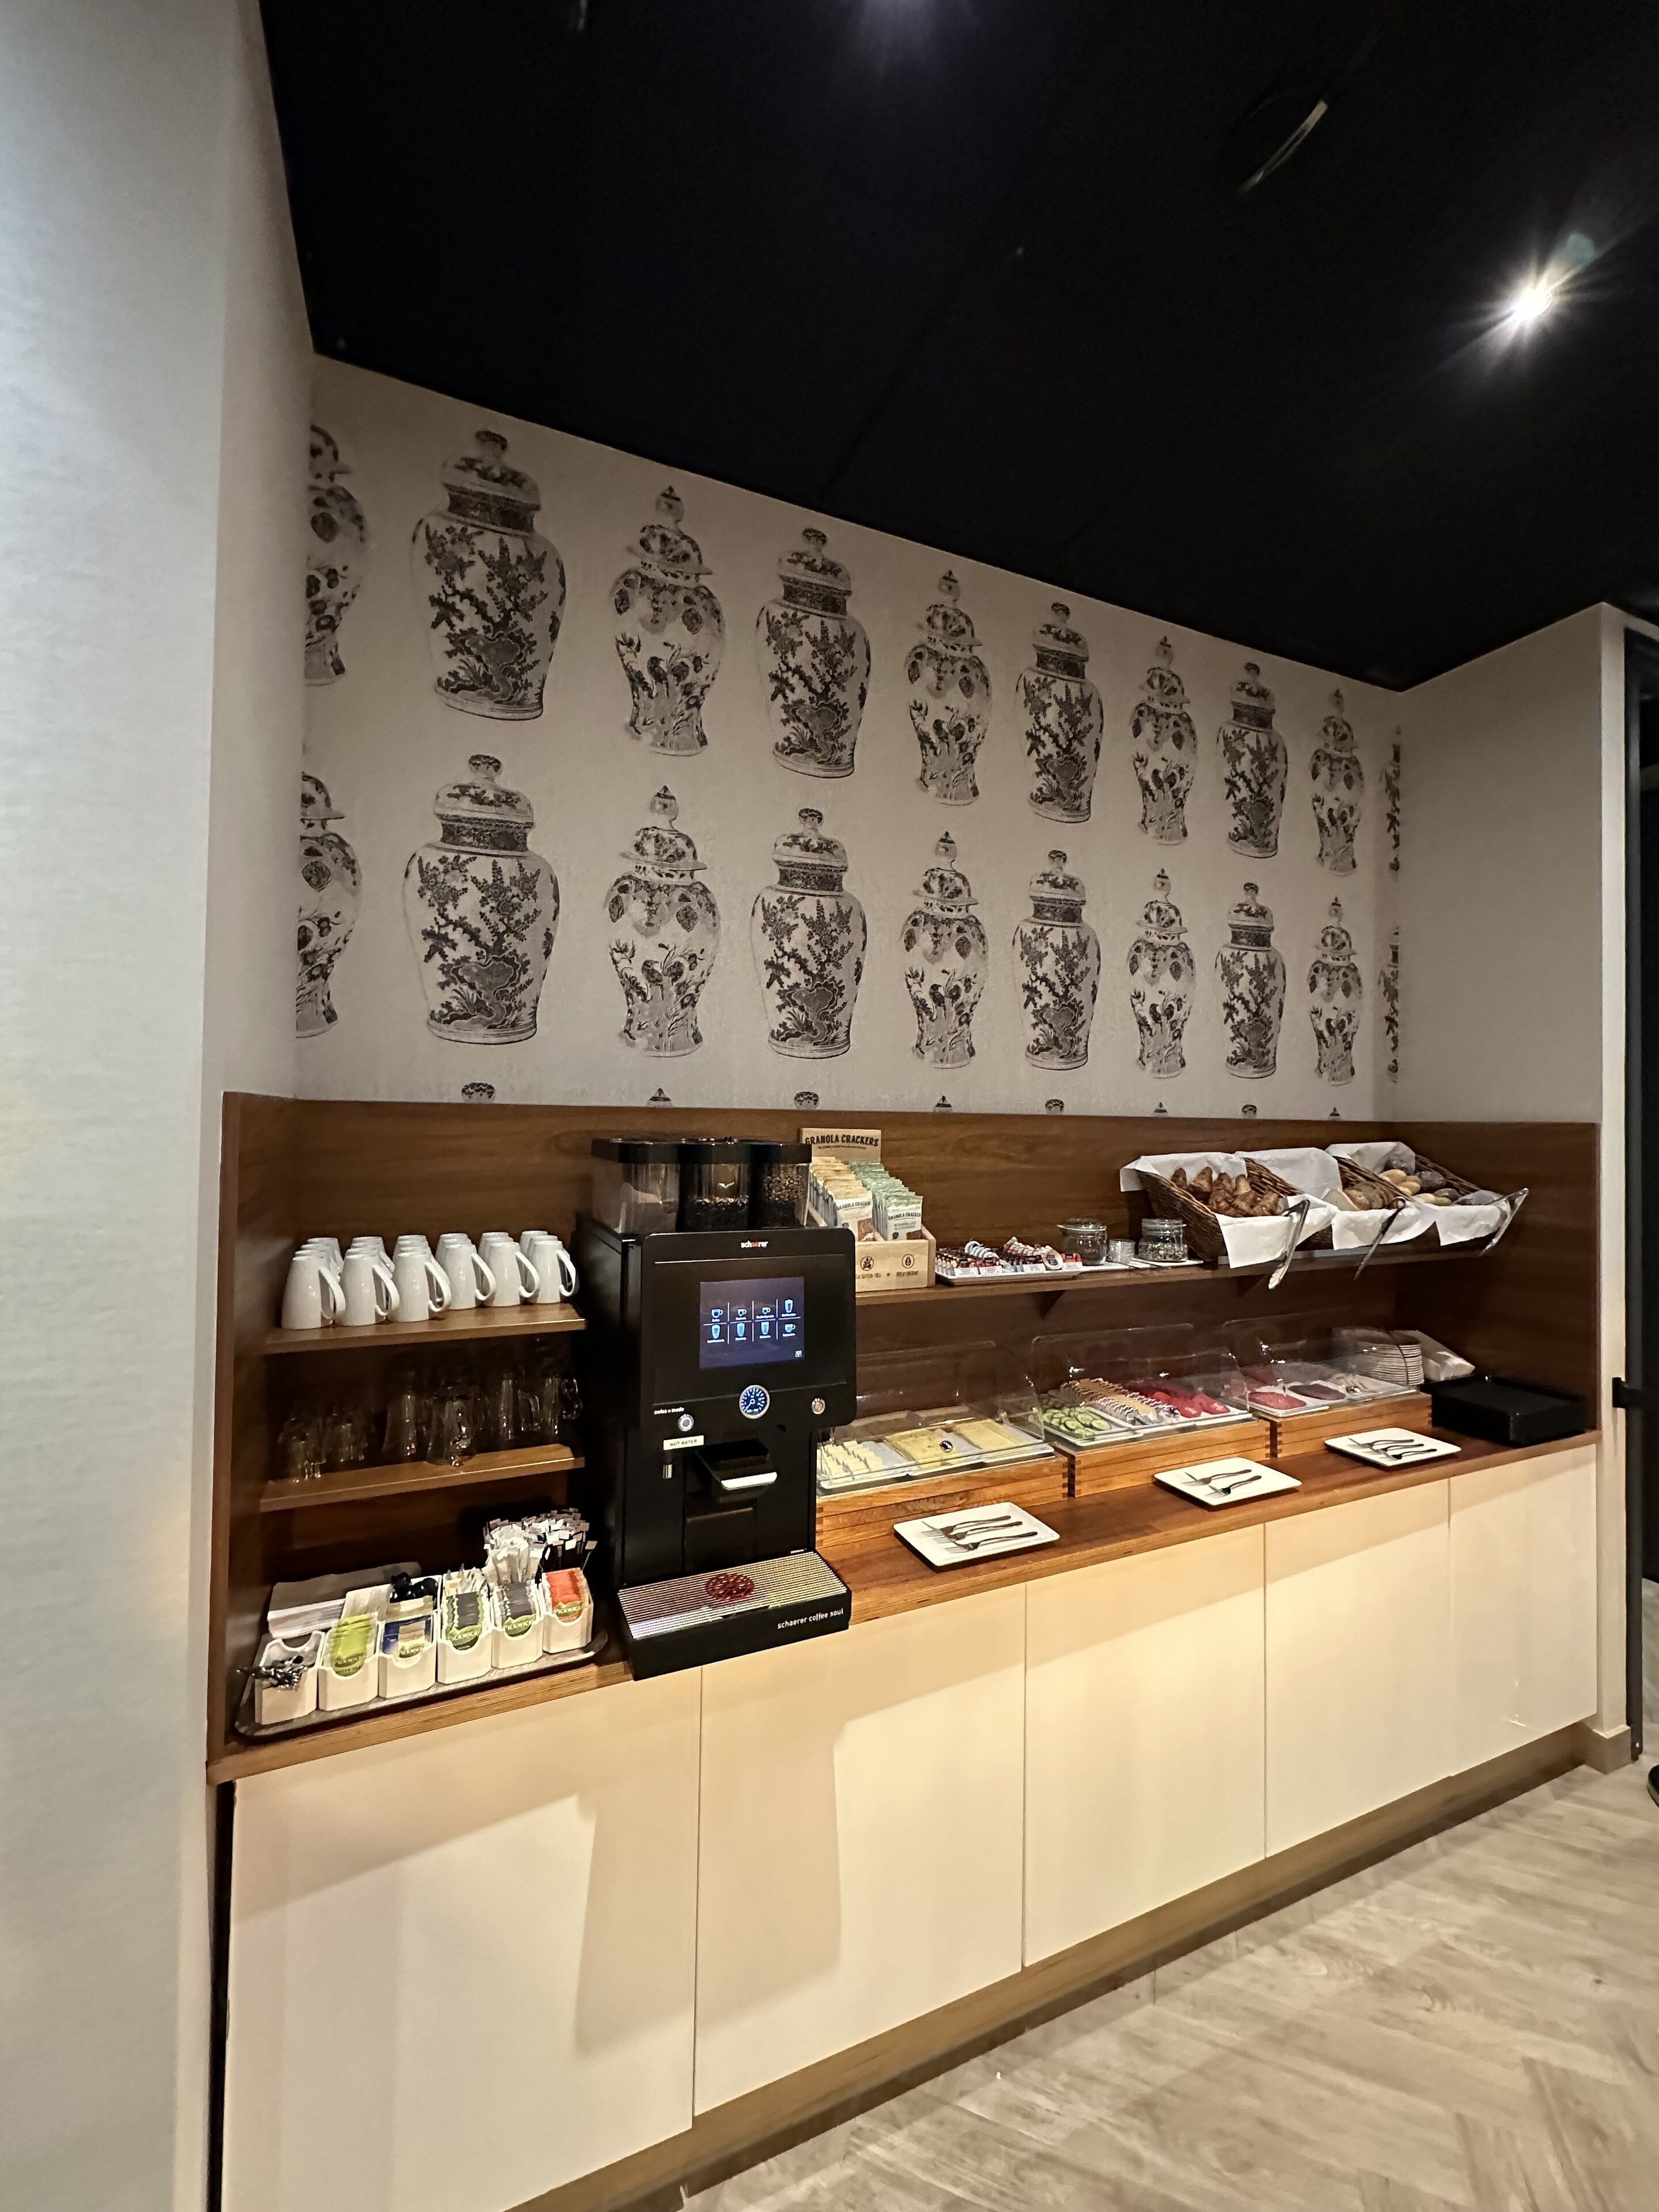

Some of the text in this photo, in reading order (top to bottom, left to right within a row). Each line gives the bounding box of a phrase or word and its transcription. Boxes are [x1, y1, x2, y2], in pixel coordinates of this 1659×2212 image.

[805, 1134, 879, 1146] GRANOLA CRACKERS
[556, 1606, 581, 1614] PICKWICK
[777, 1607, 844, 1629] schaerer coffee soul
[449, 1631, 479, 1641] PICKWICK
